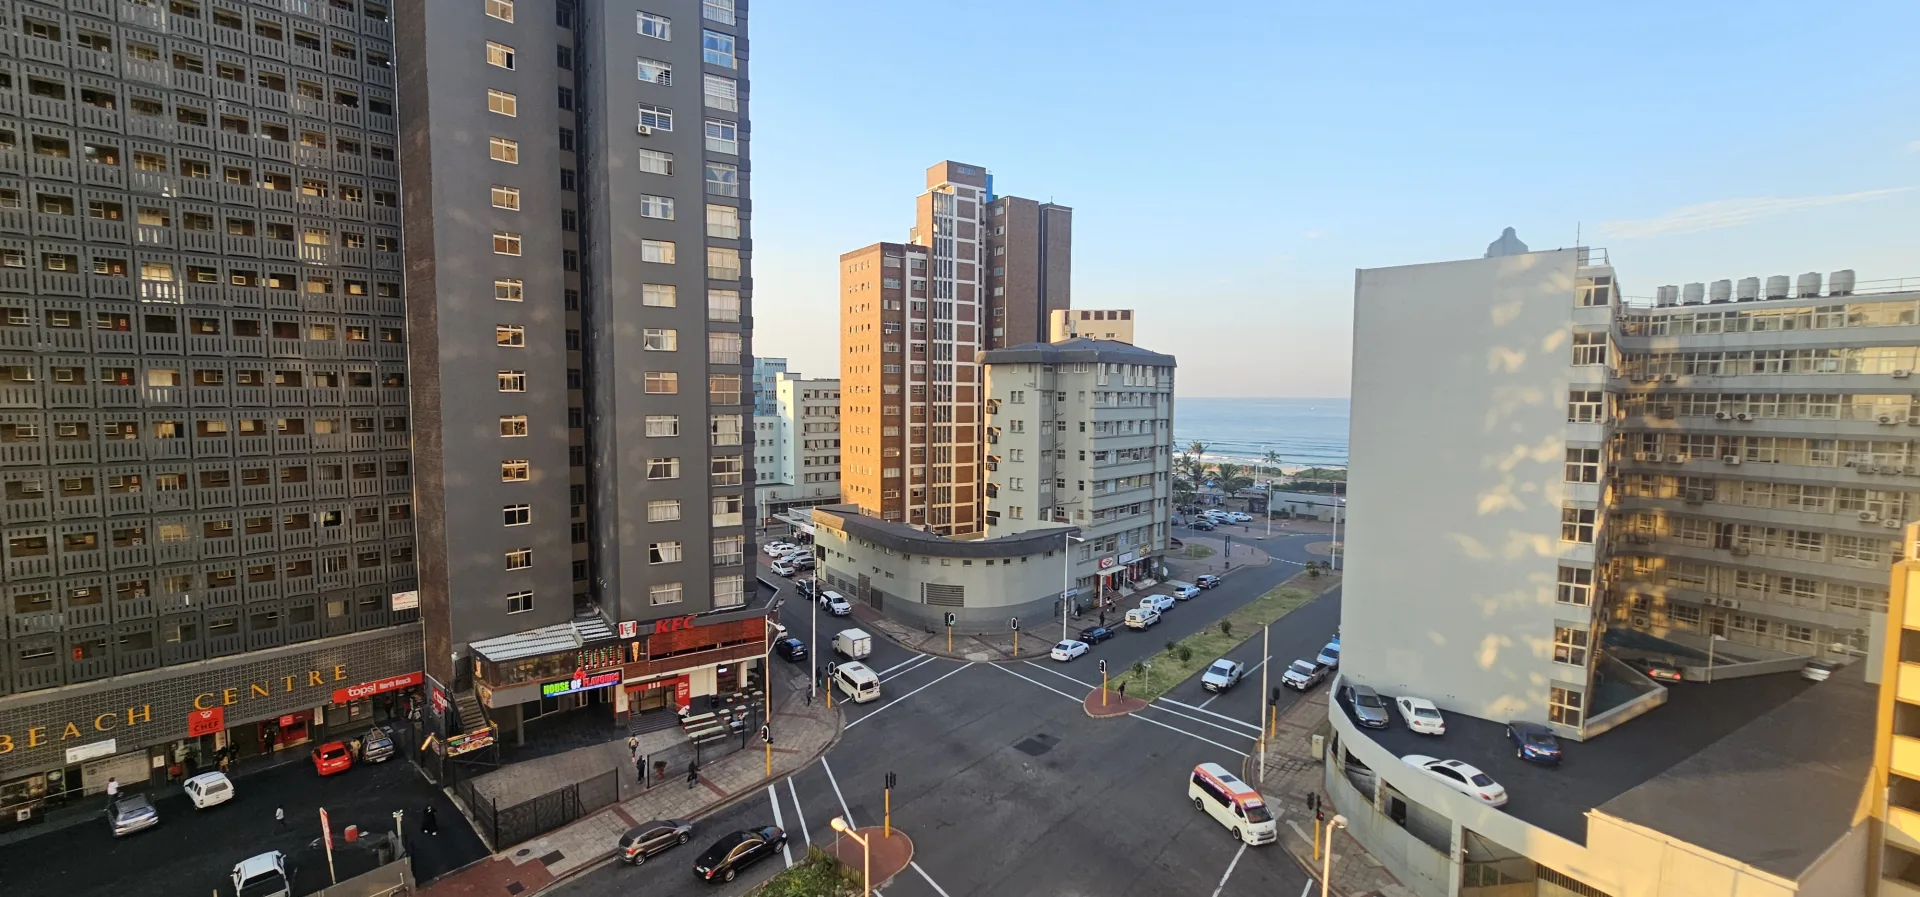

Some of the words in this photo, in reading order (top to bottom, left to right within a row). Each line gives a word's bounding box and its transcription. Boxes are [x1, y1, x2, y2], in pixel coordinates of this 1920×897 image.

[654, 615, 697, 635] KFC
[347, 682, 376, 697] tops!
[379, 681, 395, 690] North
[543, 681, 570, 695] HOUSE
[570, 678, 582, 690] OF
[0, 703, 152, 754] BEACH
[193, 664, 348, 710] CENTRE
[194, 720, 219, 732] CHEF
